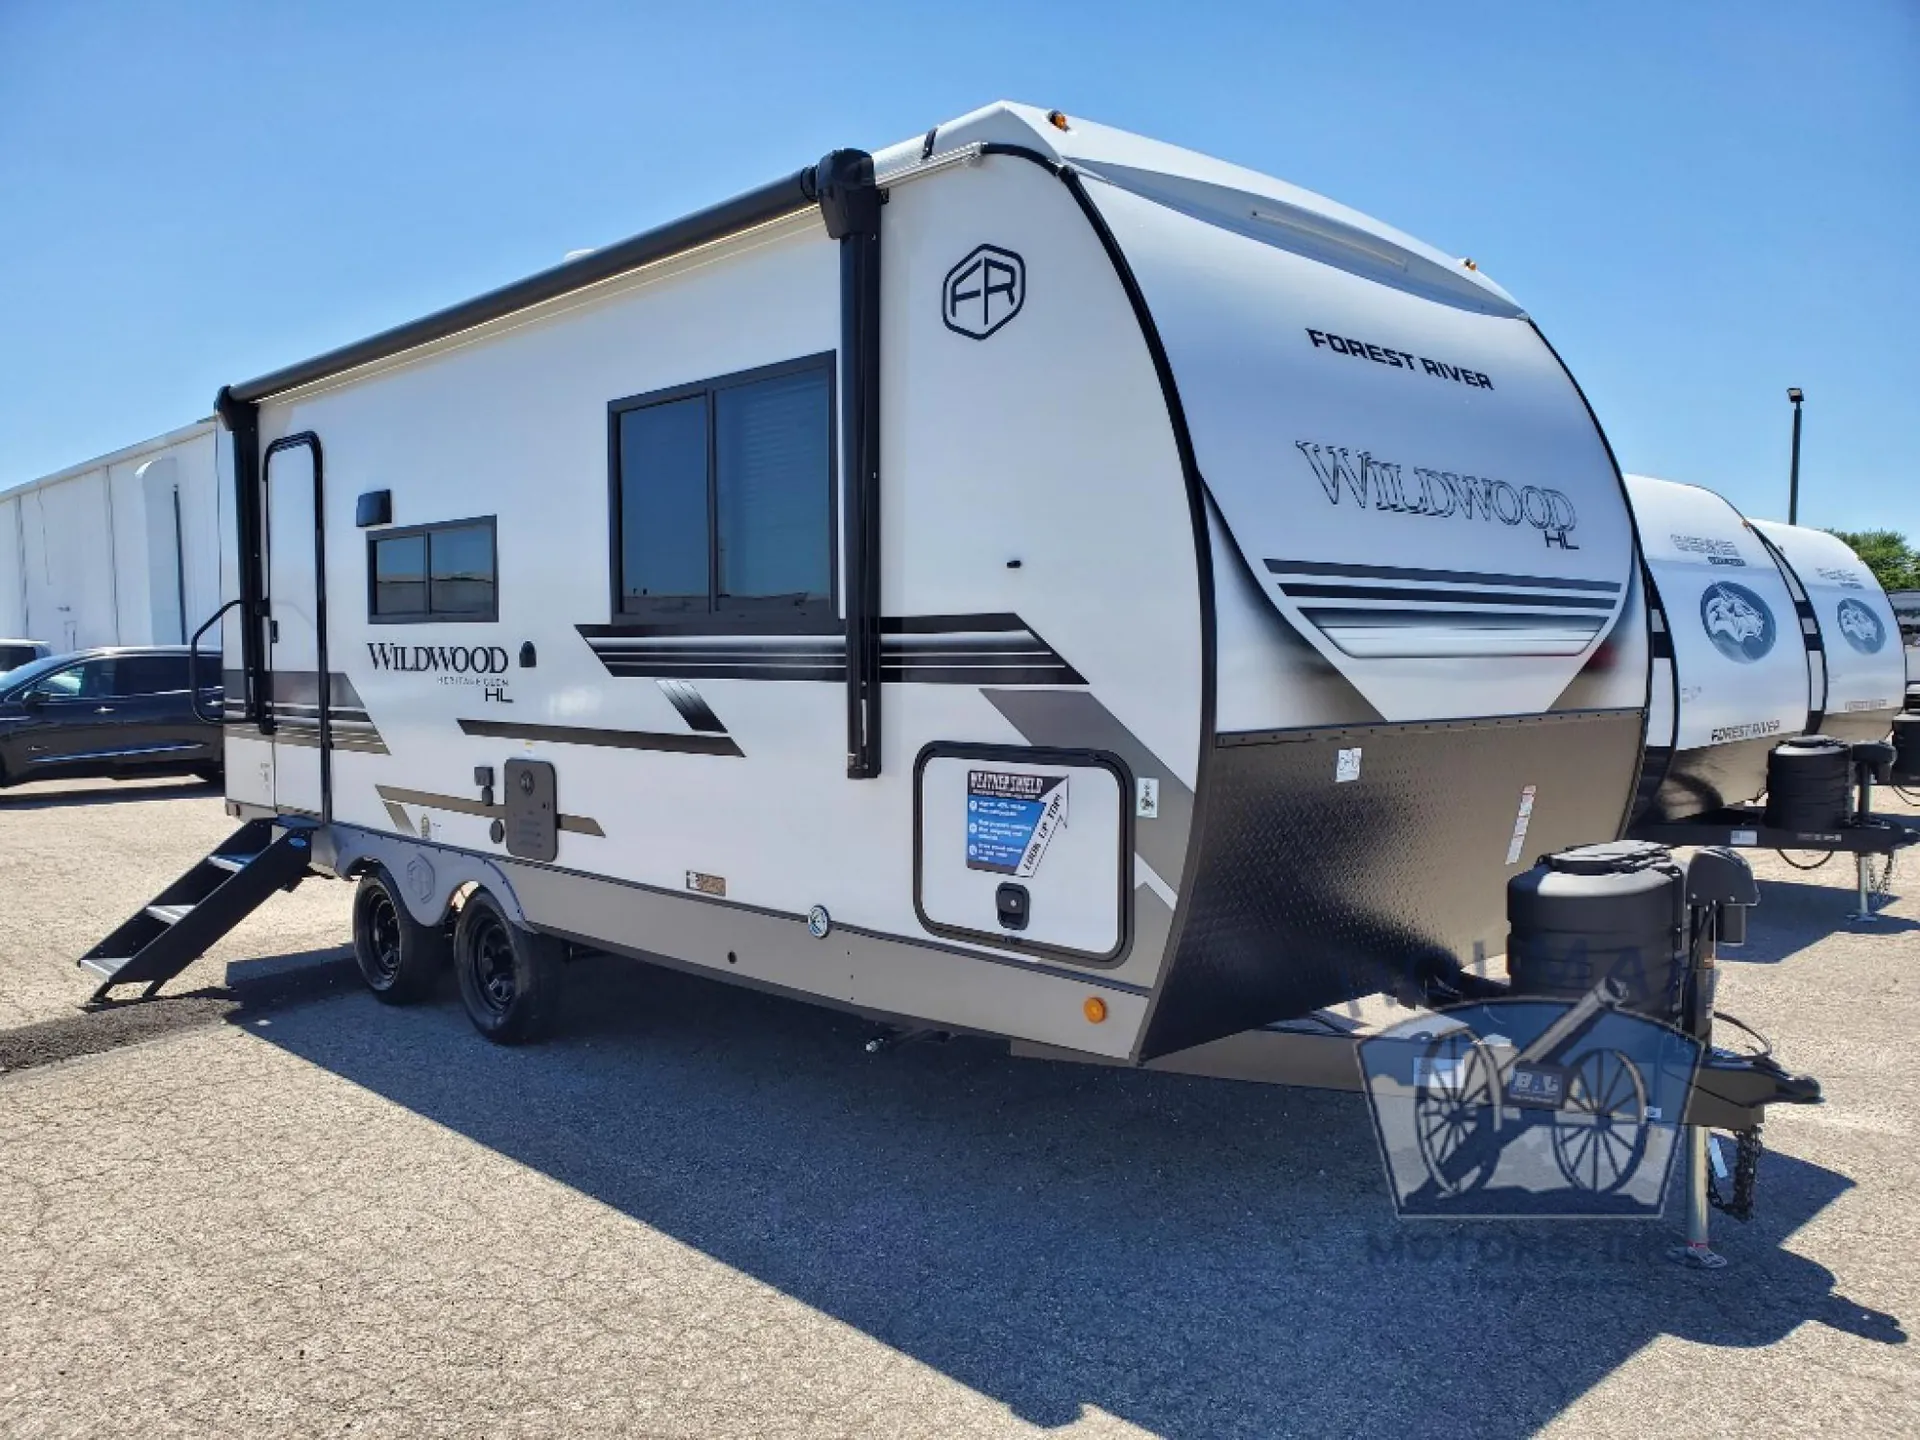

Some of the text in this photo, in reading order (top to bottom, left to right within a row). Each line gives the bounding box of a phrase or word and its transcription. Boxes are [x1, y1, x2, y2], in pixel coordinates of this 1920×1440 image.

[1305, 327, 1495, 391] FOREST RIVER
[1295, 439, 1577, 532] WILDWOOD
[1544, 530, 1580, 550] HL
[366, 642, 509, 674] WILDWOOD
[484, 687, 514, 703] HL
